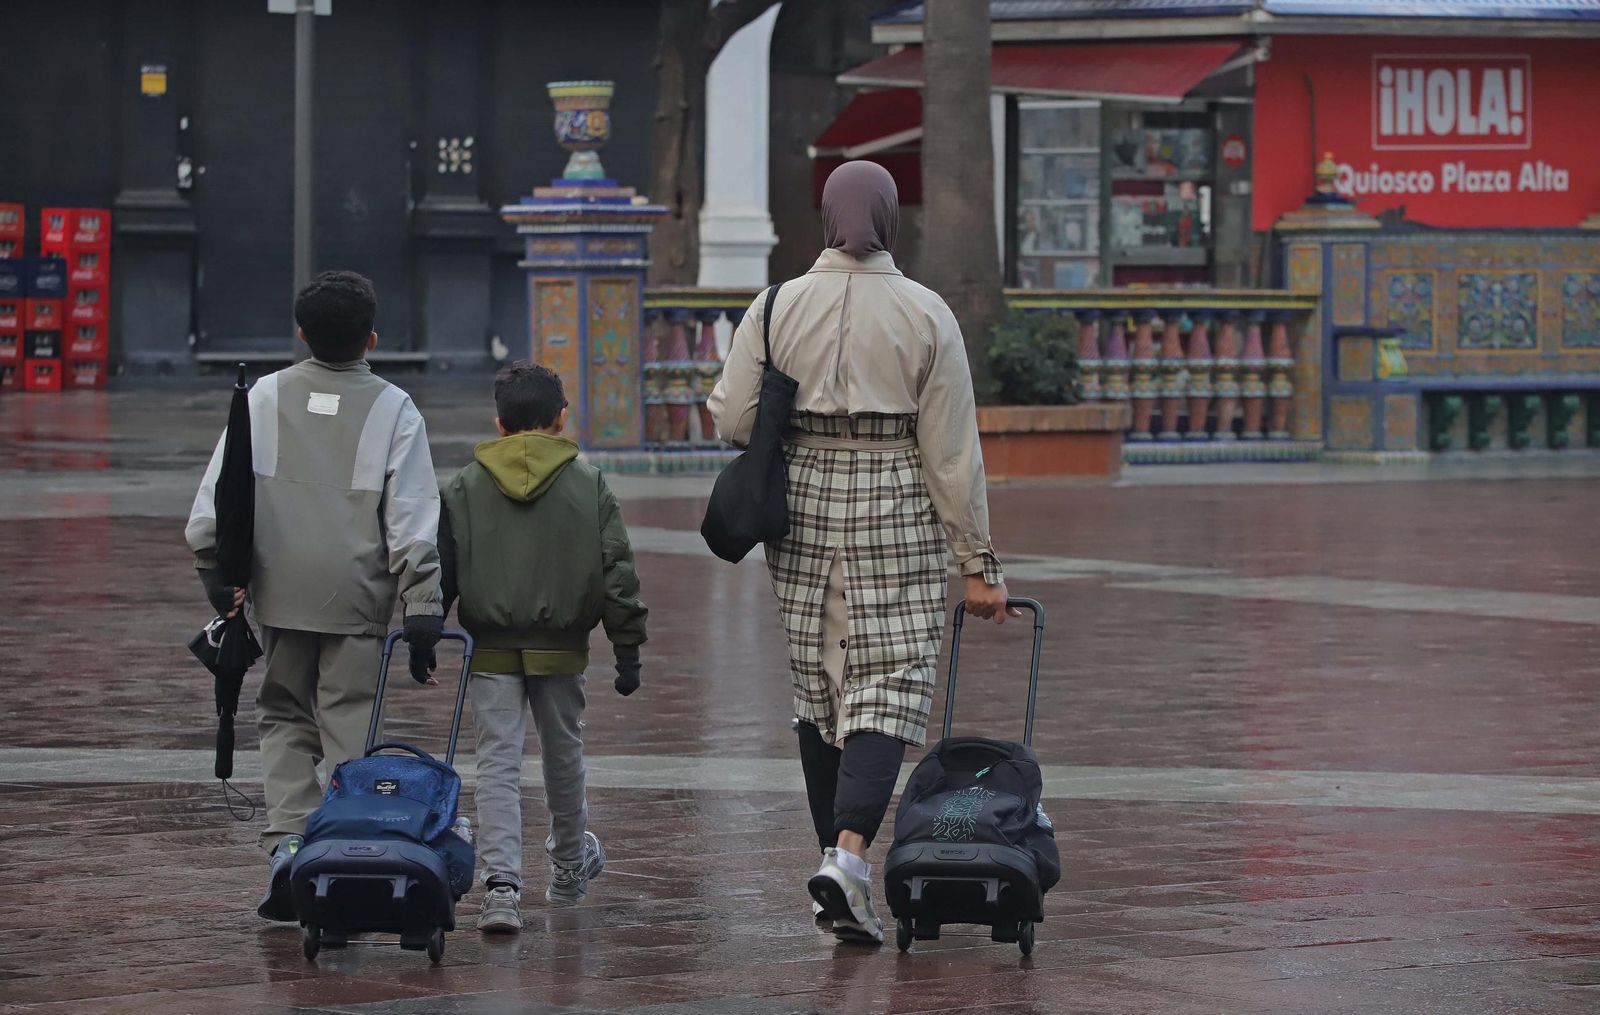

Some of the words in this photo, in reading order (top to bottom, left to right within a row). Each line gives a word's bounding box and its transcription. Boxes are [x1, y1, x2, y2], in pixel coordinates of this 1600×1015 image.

[1380, 66, 1524, 136] ¡HOLA!
[1333, 163, 1435, 196] Quiosco
[1441, 161, 1511, 192] Plaza
[1517, 160, 1569, 191] Alta
